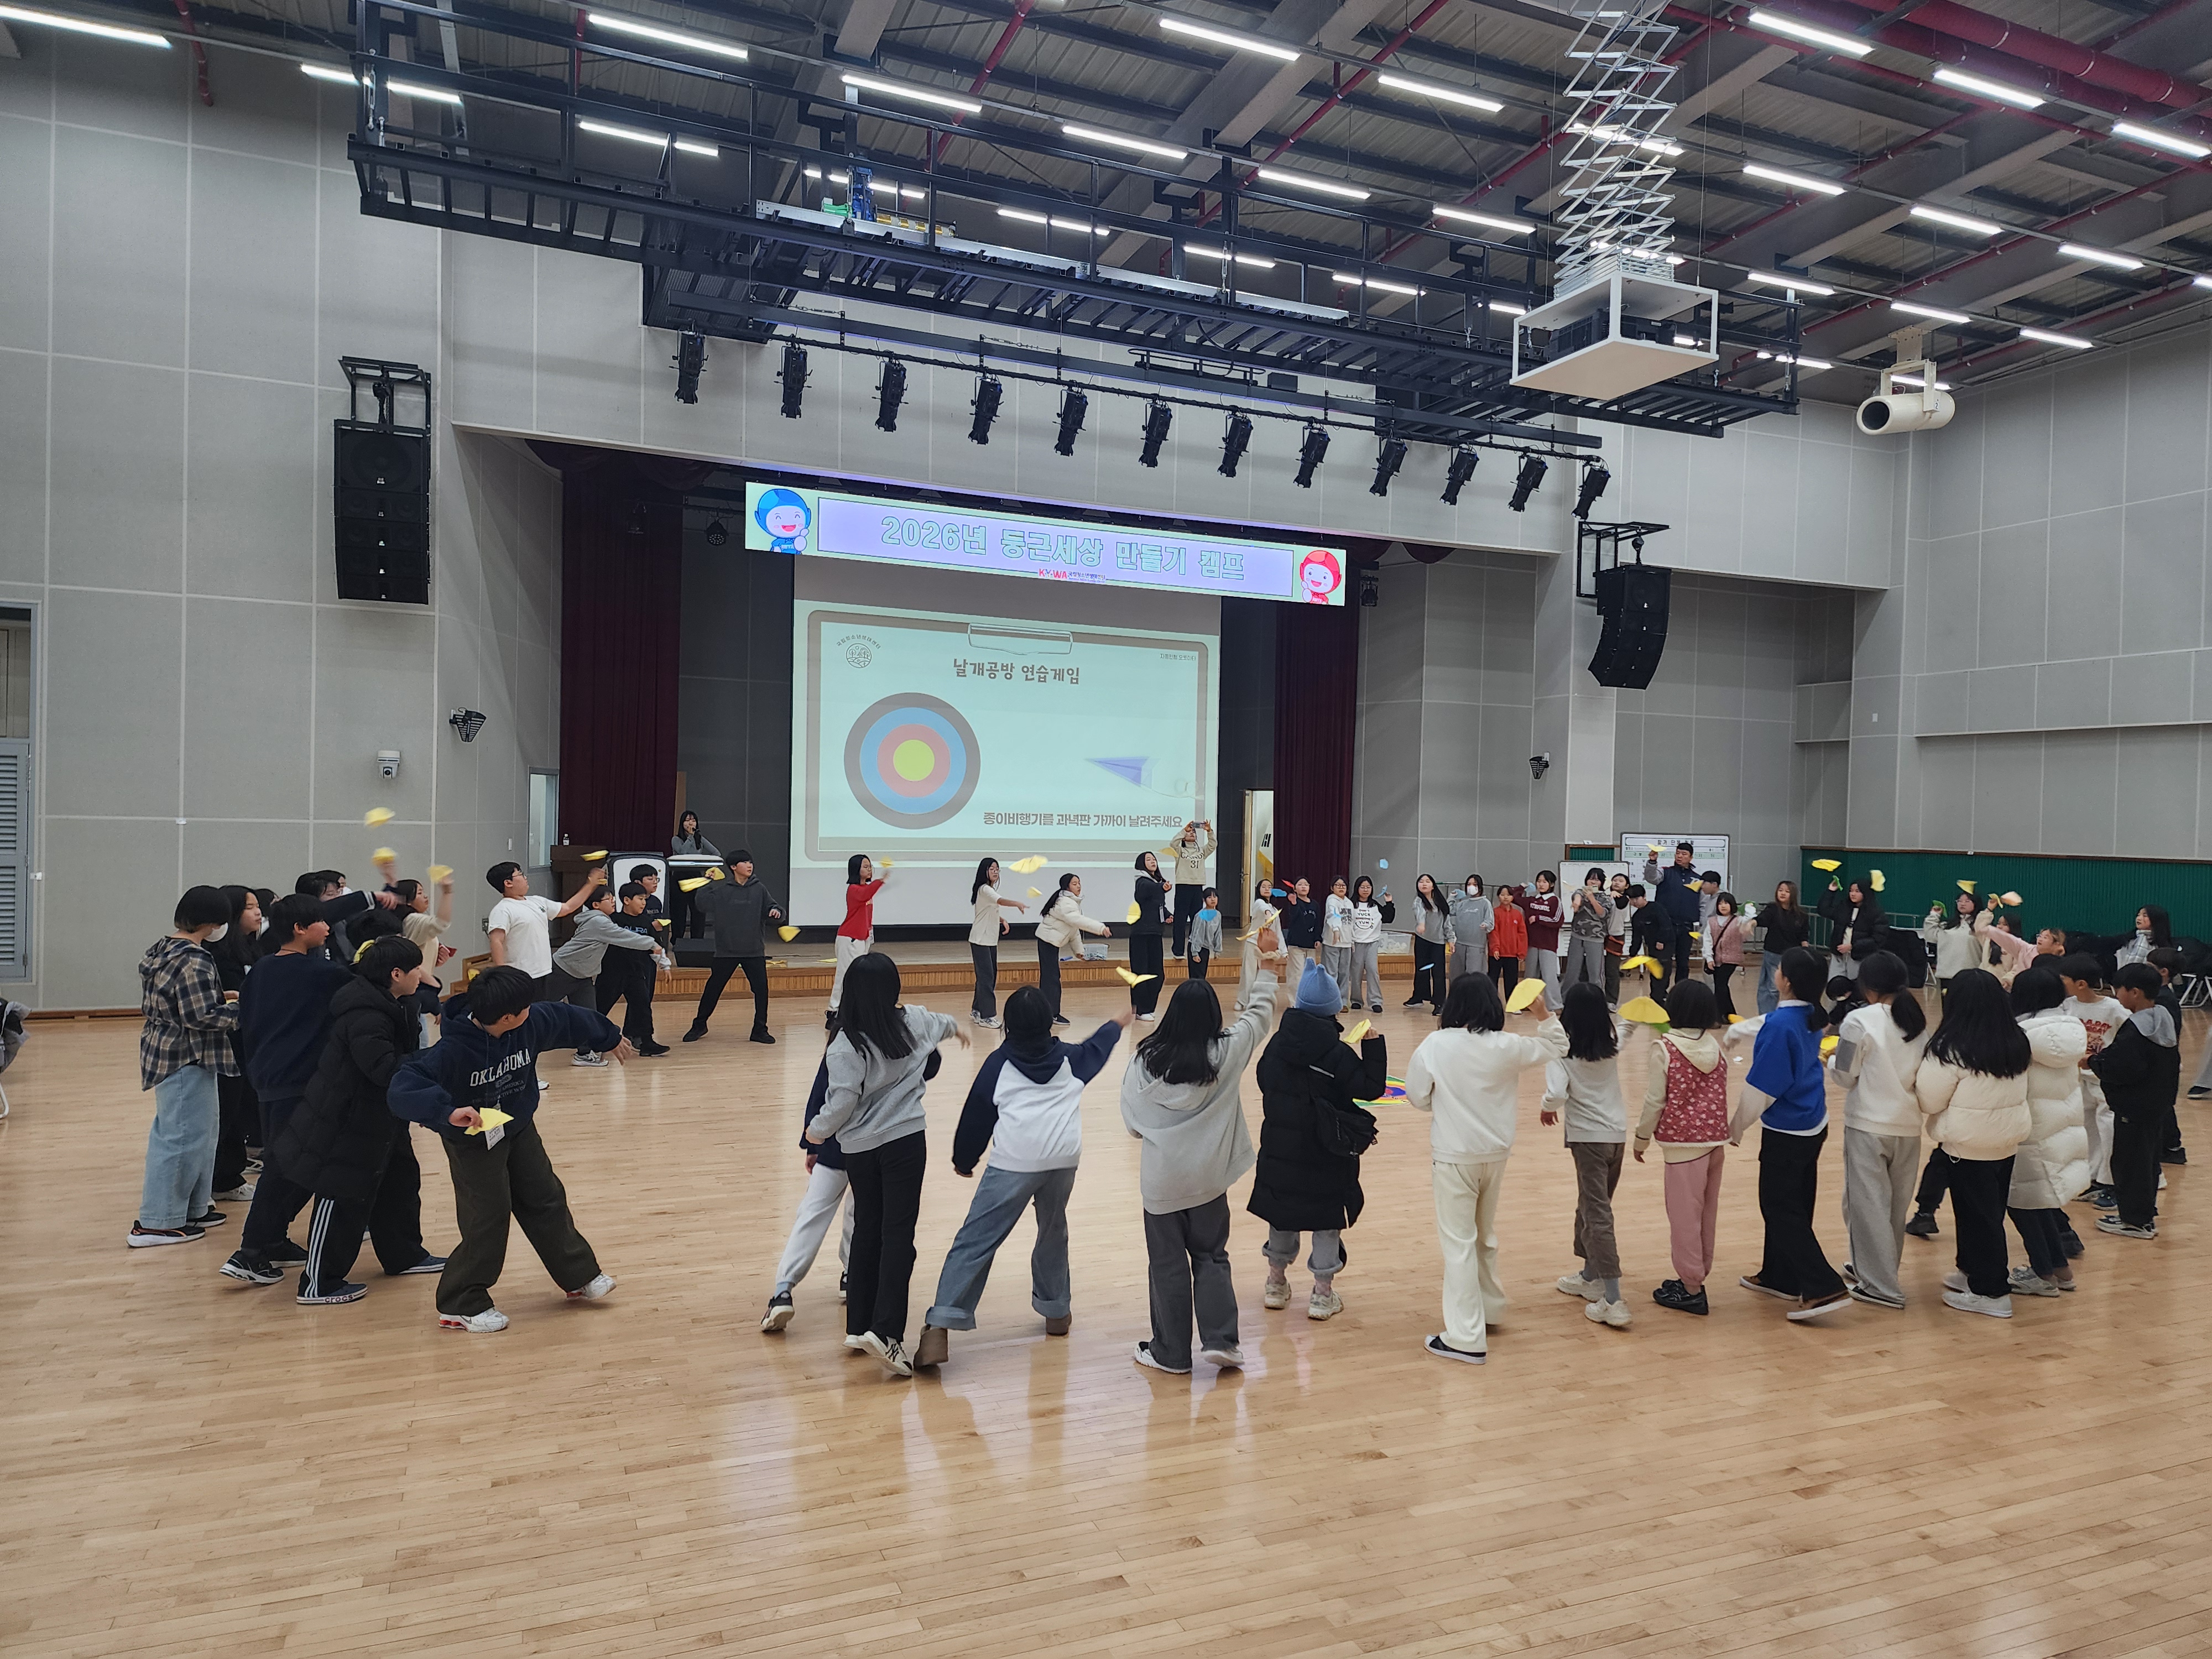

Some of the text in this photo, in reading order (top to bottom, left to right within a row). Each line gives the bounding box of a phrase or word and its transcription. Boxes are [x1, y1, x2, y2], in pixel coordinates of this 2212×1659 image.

[881, 517, 1245, 581] 2026년 둥근세상 만들기 캠프
[953, 658, 1015, 680] 날개공방
[983, 812, 1183, 828] 종이비행기를 과녁판 가까이 날려주세요
[1190, 860, 1199, 869] 31
[470, 1048, 531, 1087] OKLAHOMA
[325, 1294, 353, 1303] crocs
